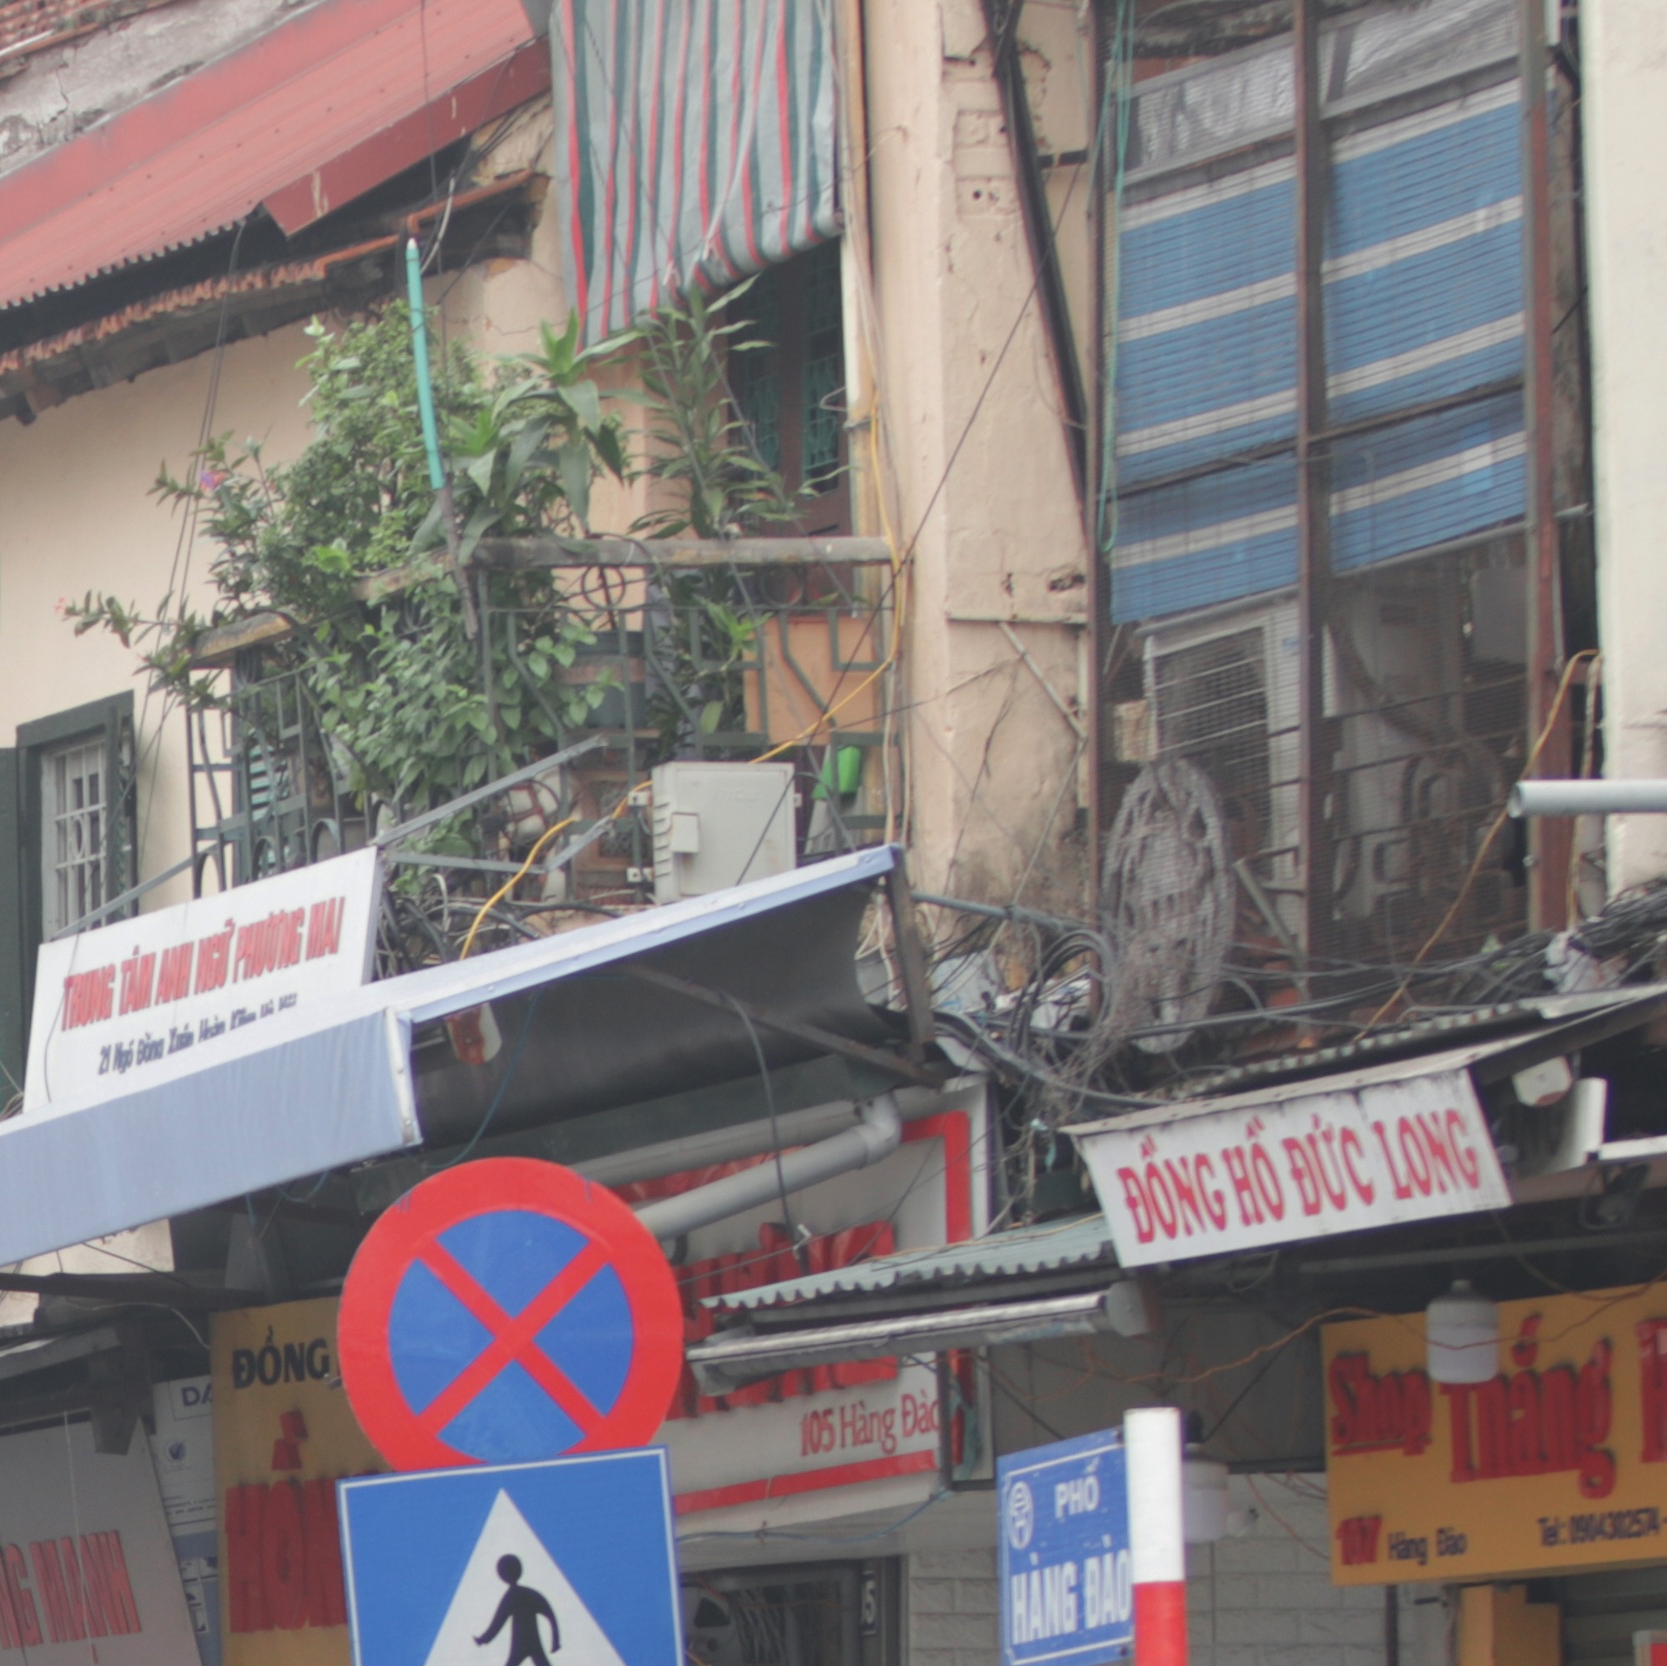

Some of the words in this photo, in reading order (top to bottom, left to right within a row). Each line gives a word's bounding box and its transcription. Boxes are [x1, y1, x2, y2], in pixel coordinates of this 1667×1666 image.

[61, 963, 116, 1032] TRUNG
[119, 945, 156, 1016] TÂM
[155, 941, 194, 1006] ANH
[194, 918, 234, 996] NGỮ
[305, 896, 346, 961] MAI
[98, 1044, 113, 1076] 21
[1116, 1134, 1227, 1245] ĐỒNG
[1221, 1115, 1286, 1228] HỒ
[1281, 1112, 1376, 1218] ĐỨC
[1372, 1108, 1482, 1201] LONG
[800, 1408, 837, 1457] 105
[838, 1401, 898, 1455] Hàng
[1055, 1457, 1100, 1519] PHỐ
[29, 1529, 143, 1665] MẠNH
[1011, 1552, 1077, 1645] HÀNG
